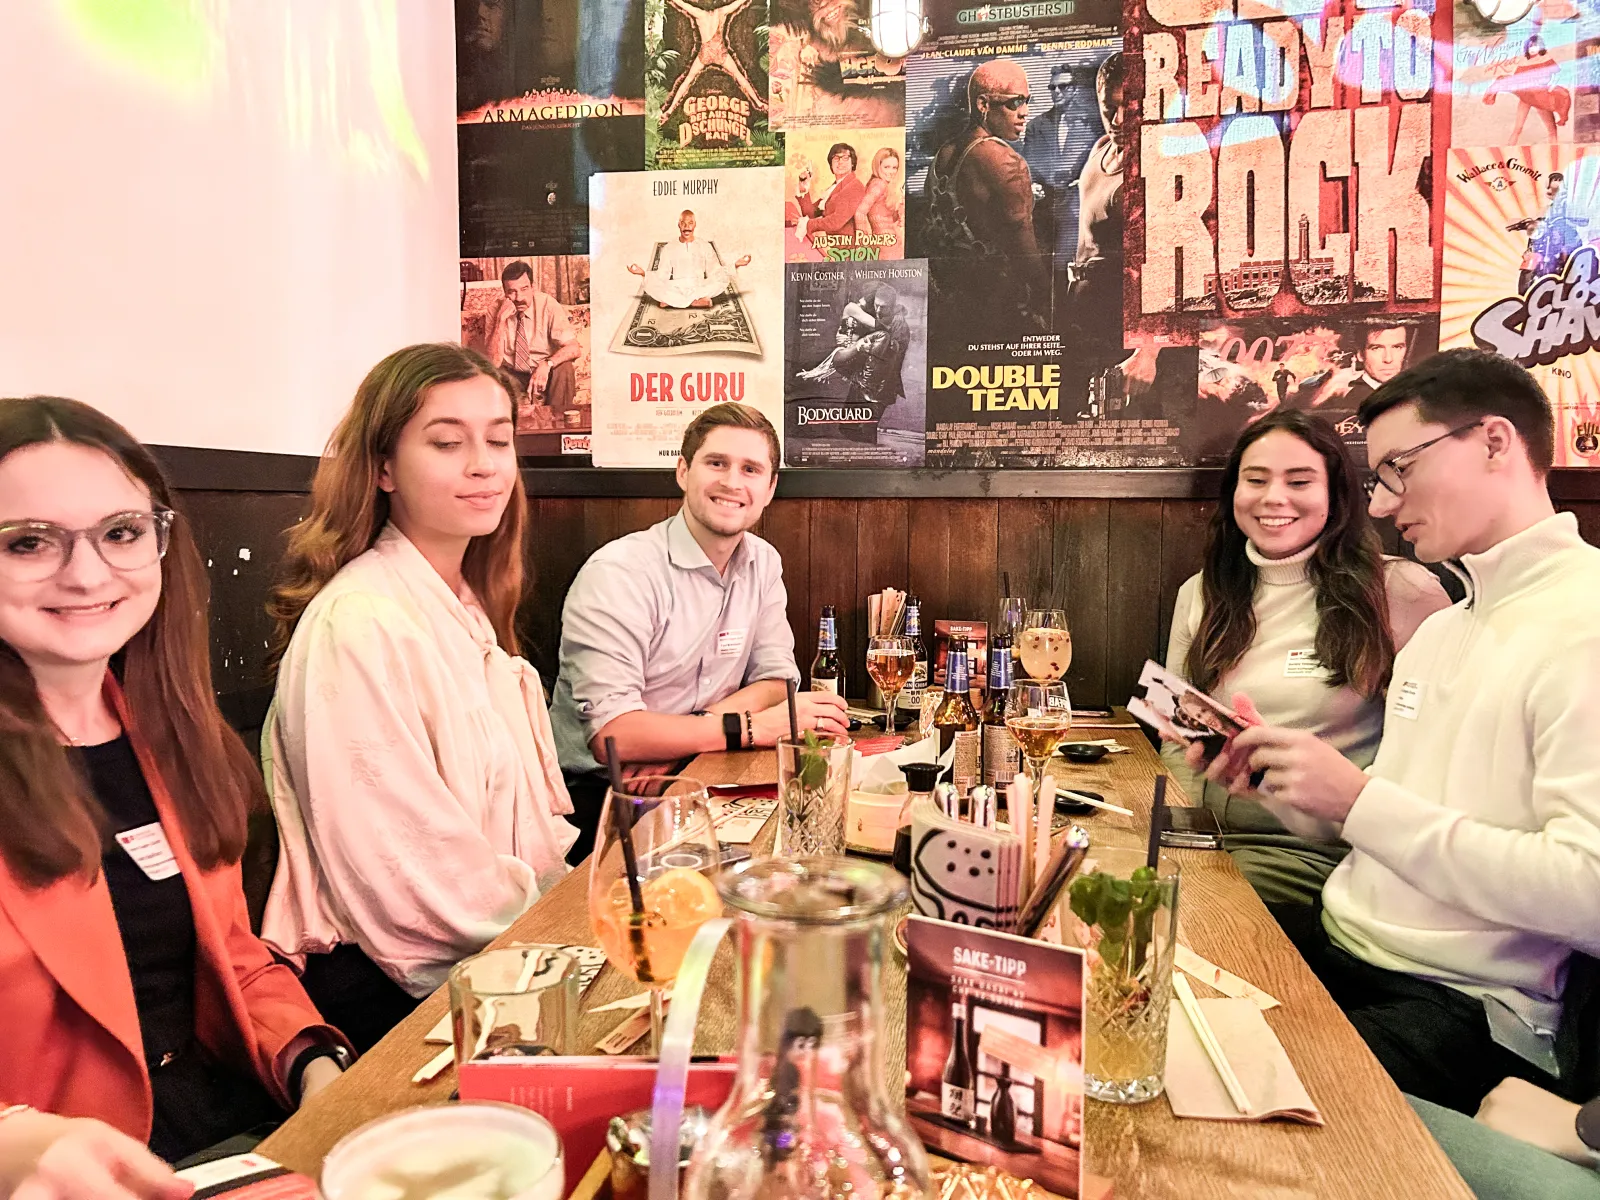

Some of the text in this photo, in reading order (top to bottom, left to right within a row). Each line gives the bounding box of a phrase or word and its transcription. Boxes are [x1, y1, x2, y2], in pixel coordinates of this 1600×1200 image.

[959, 2, 1074, 22] GHOSTBUSTERS II
[921, 39, 1113, 59] JEAN-CLAUDE VAN DAMME DENNIS RODMAN
[1143, 9, 1432, 120] READY TO
[482, 103, 623, 123] ARMAGEDDON
[684, 96, 750, 116] GEORGE
[690, 110, 747, 125] DER AUS DEM
[679, 119, 753, 148] DSCHUNGEL
[706, 132, 728, 141] KAM
[1456, 161, 1497, 183] Wallace
[1506, 157, 1543, 182] Gromit
[653, 179, 719, 196] EDDIE MURPHY
[1141, 101, 1433, 314] ROCK
[812, 230, 897, 249] AUSTIN POWERS
[824, 247, 880, 261] SPION
[791, 269, 922, 281] KEVIN COSTNER WHITNEY HOUSTON
[1566, 250, 1593, 284] A
[1220, 336, 1302, 362] 007
[933, 364, 1061, 389] DOUBLE
[1551, 367, 1572, 379] KINO
[631, 372, 745, 401] DER GURU
[967, 388, 1059, 411] TEAM
[798, 406, 872, 425] BODYGUARD
[563, 436, 592, 452] Denni
[953, 946, 1027, 977] SAKE-TIPP
